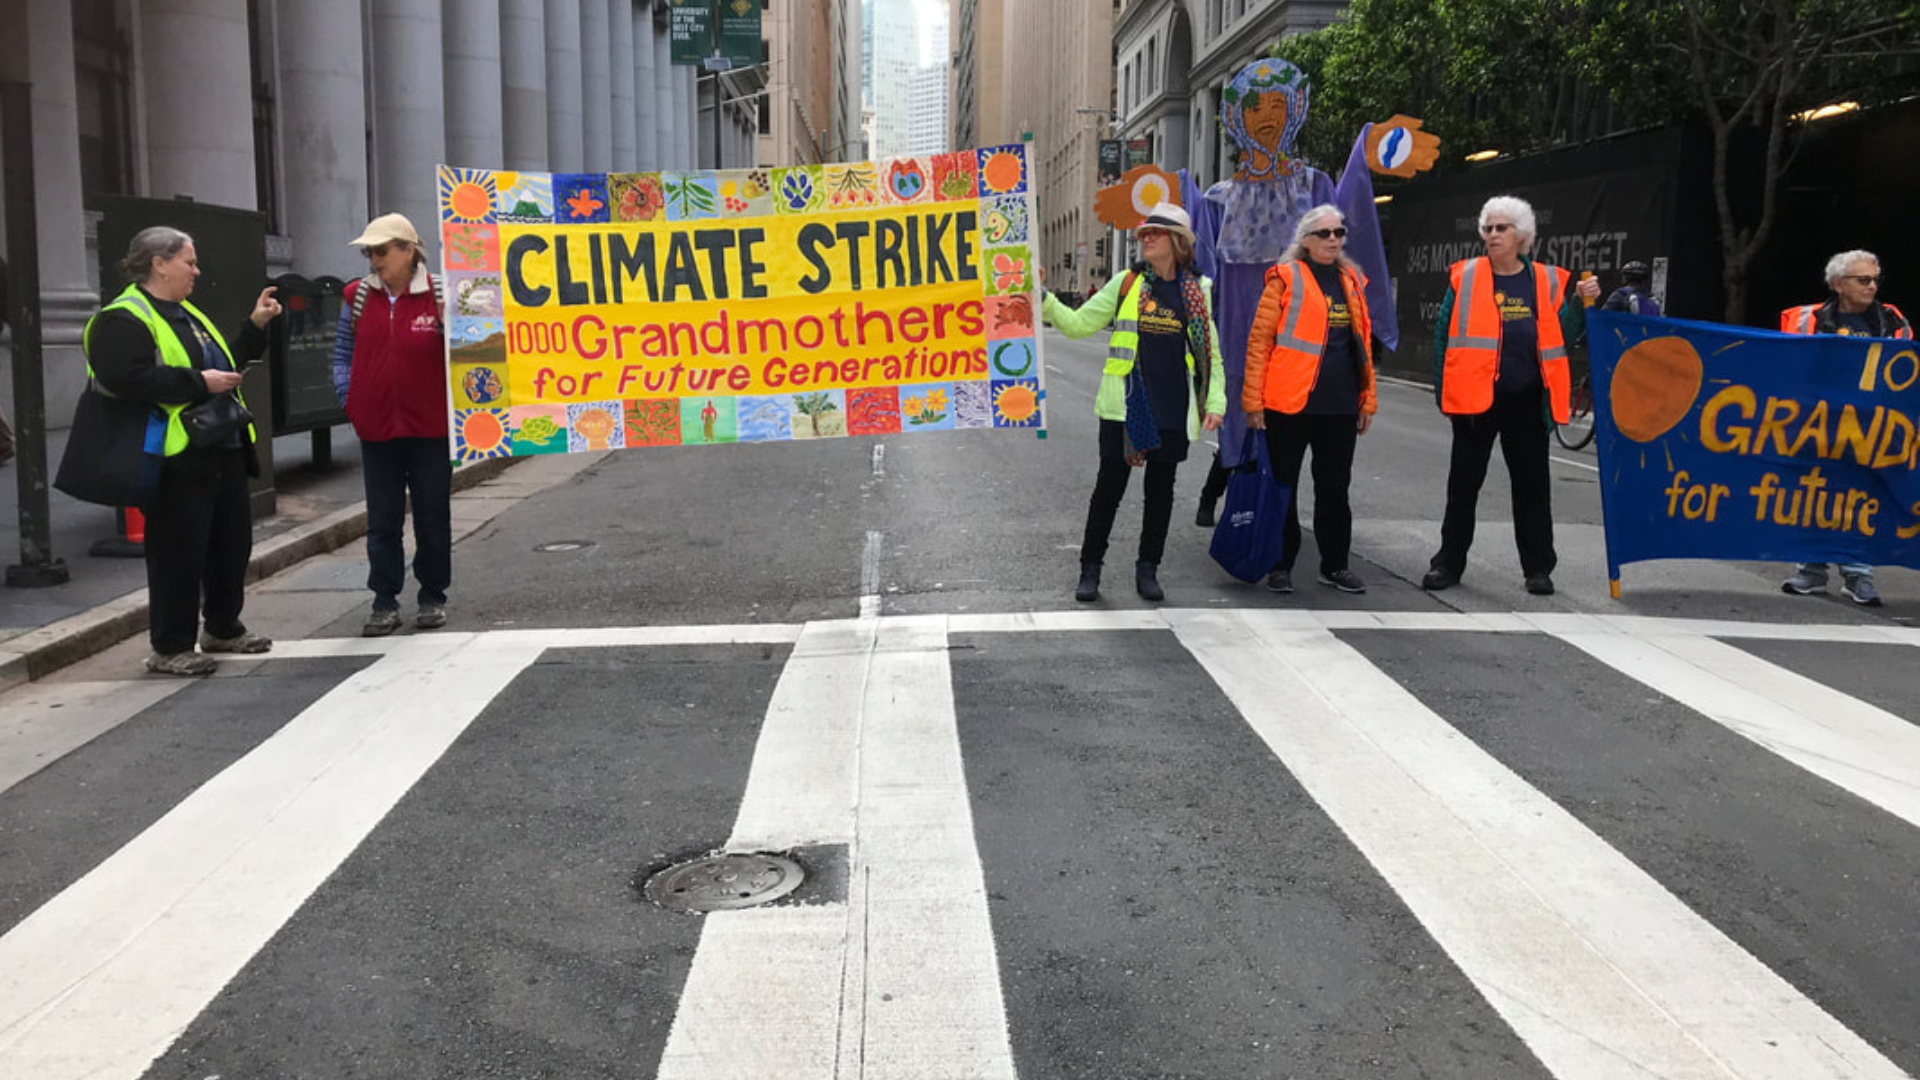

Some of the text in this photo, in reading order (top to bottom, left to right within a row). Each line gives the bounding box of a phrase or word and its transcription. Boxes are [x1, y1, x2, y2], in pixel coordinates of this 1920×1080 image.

[505, 211, 979, 306] CLIMATE STRIKE
[1407, 246, 1429, 273] 345
[1547, 232, 1627, 270] STREET
[508, 300, 984, 359] 1000 Grandmothers
[533, 346, 987, 398] for Future Generations
[1665, 471, 1730, 522] for
[1750, 466, 1879, 536] future
